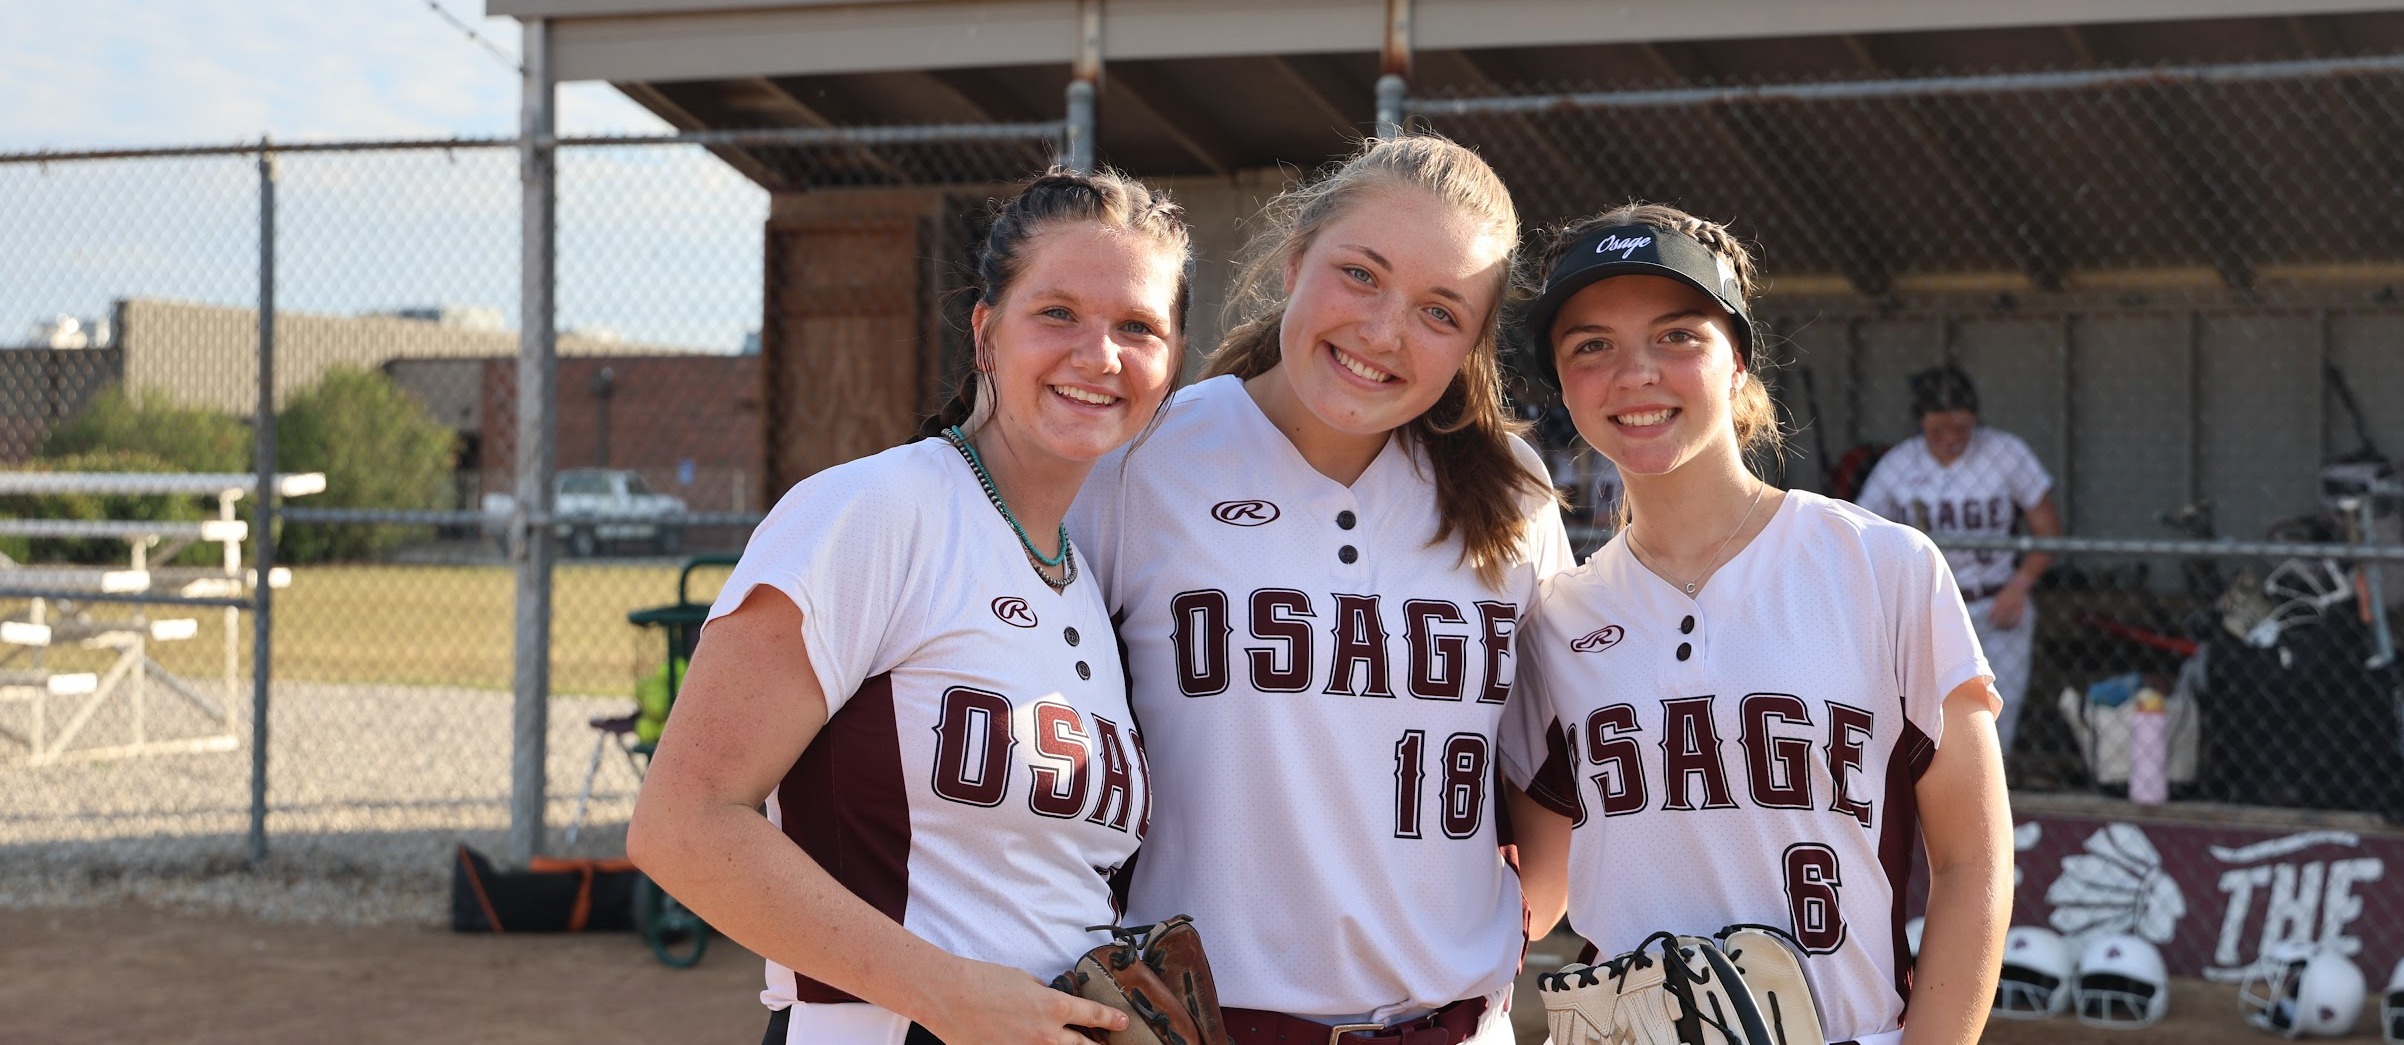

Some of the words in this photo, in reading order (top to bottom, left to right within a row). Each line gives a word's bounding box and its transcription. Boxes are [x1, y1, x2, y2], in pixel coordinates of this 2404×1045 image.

[1596, 234, 1651, 259] Osage
[1170, 588, 1517, 704] OSAGE
[1394, 729, 1489, 840] 18
[1782, 842, 1847, 957] 6
[2214, 857, 2385, 966] THE
